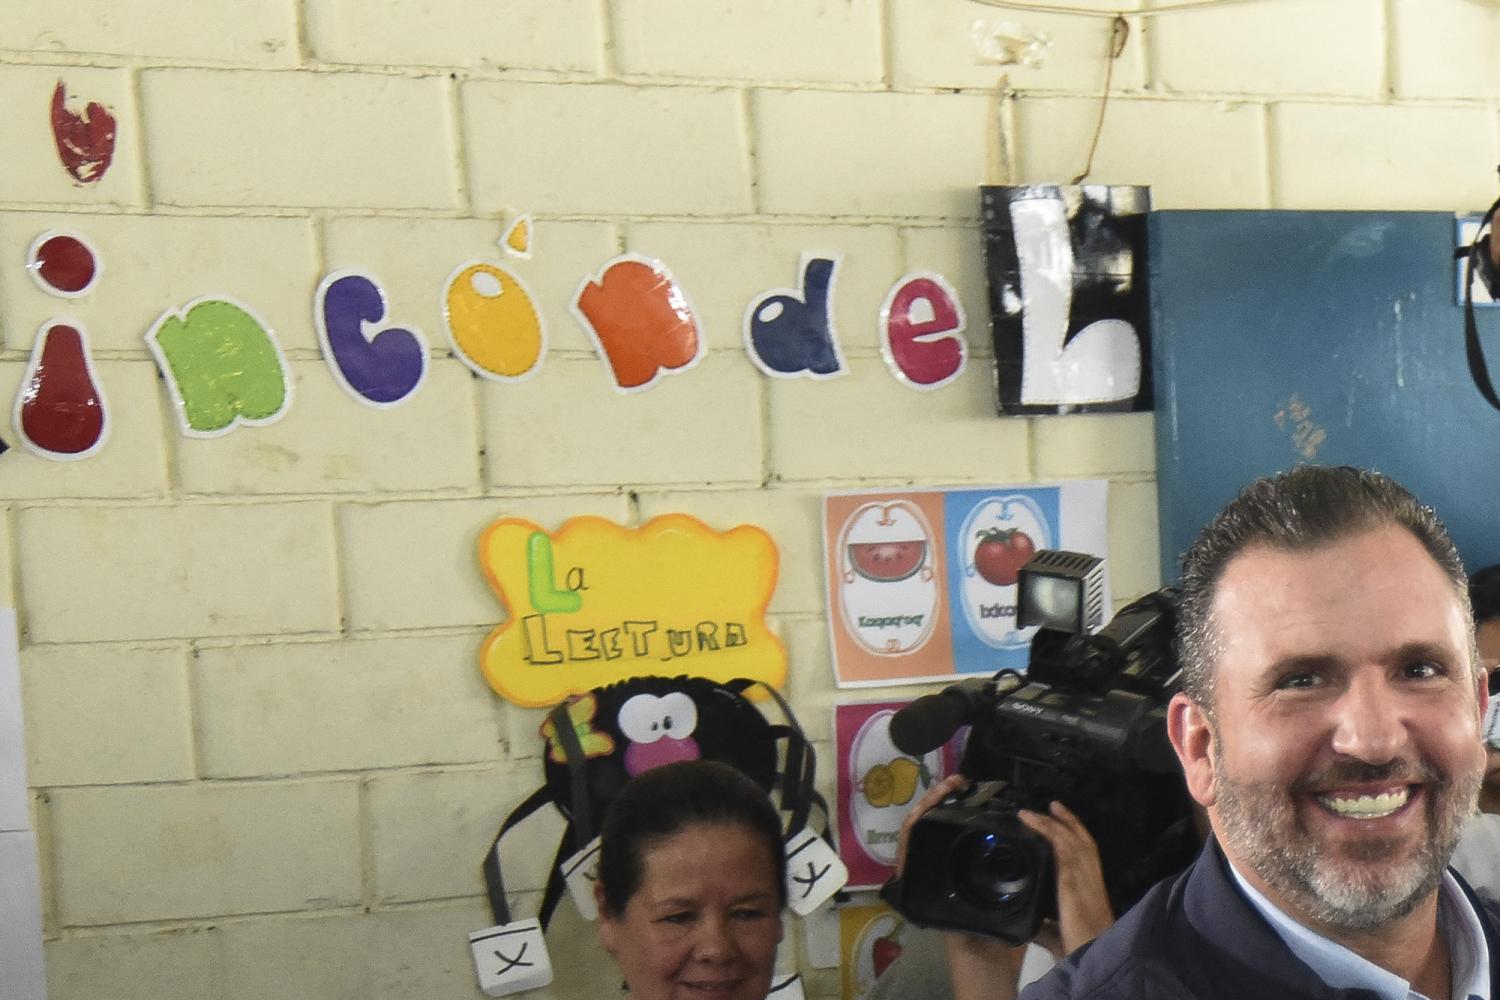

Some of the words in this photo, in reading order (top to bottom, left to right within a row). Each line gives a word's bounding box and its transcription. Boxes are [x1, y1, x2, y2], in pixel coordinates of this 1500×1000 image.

[0, 212, 706, 460] incón
[743, 250, 967, 390] de
[527, 530, 589, 614] La
